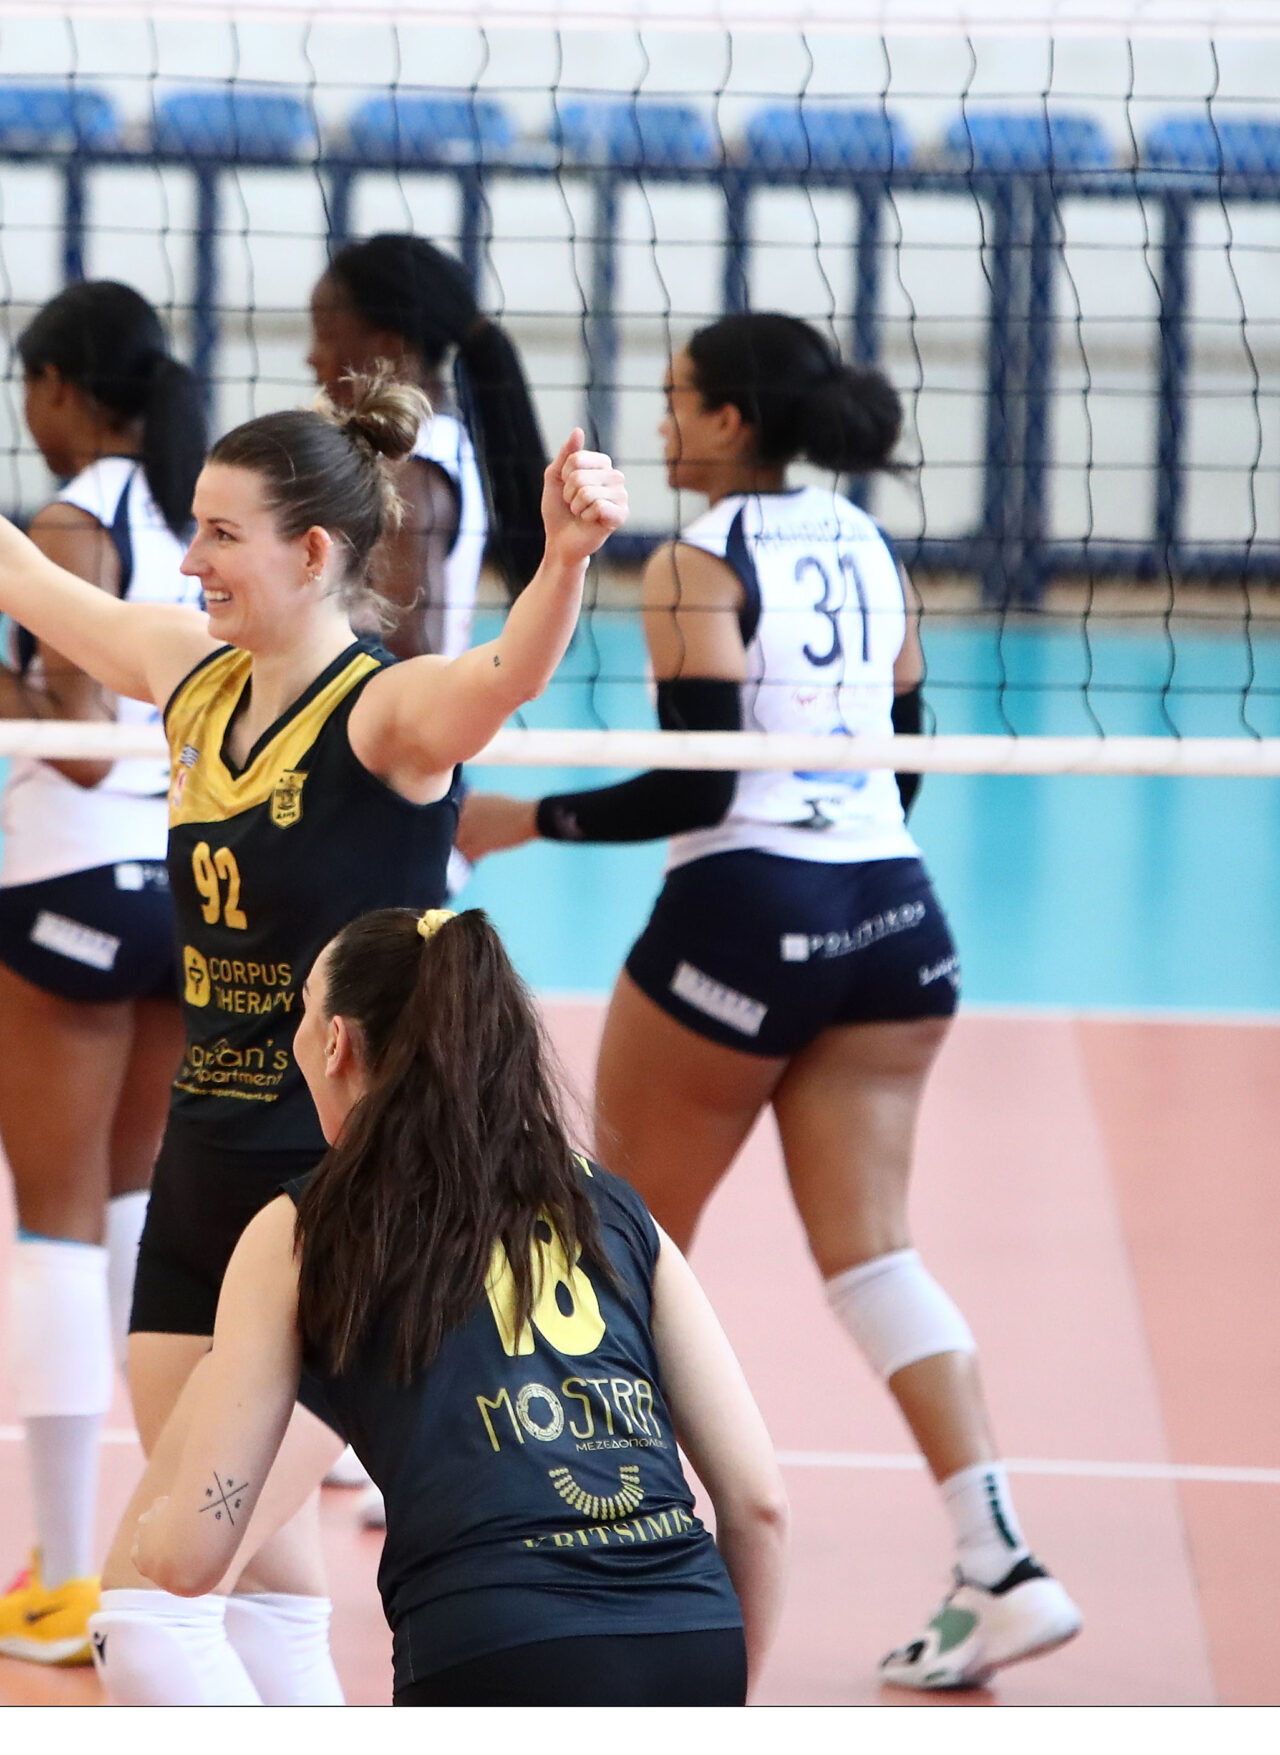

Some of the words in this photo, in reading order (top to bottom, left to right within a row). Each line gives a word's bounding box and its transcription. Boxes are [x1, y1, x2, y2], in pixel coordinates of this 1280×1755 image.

[795, 553, 870, 667] 31
[192, 841, 248, 930] 92
[209, 957, 292, 986] CORPUS
[476, 1377, 662, 1452] MOSTRA
